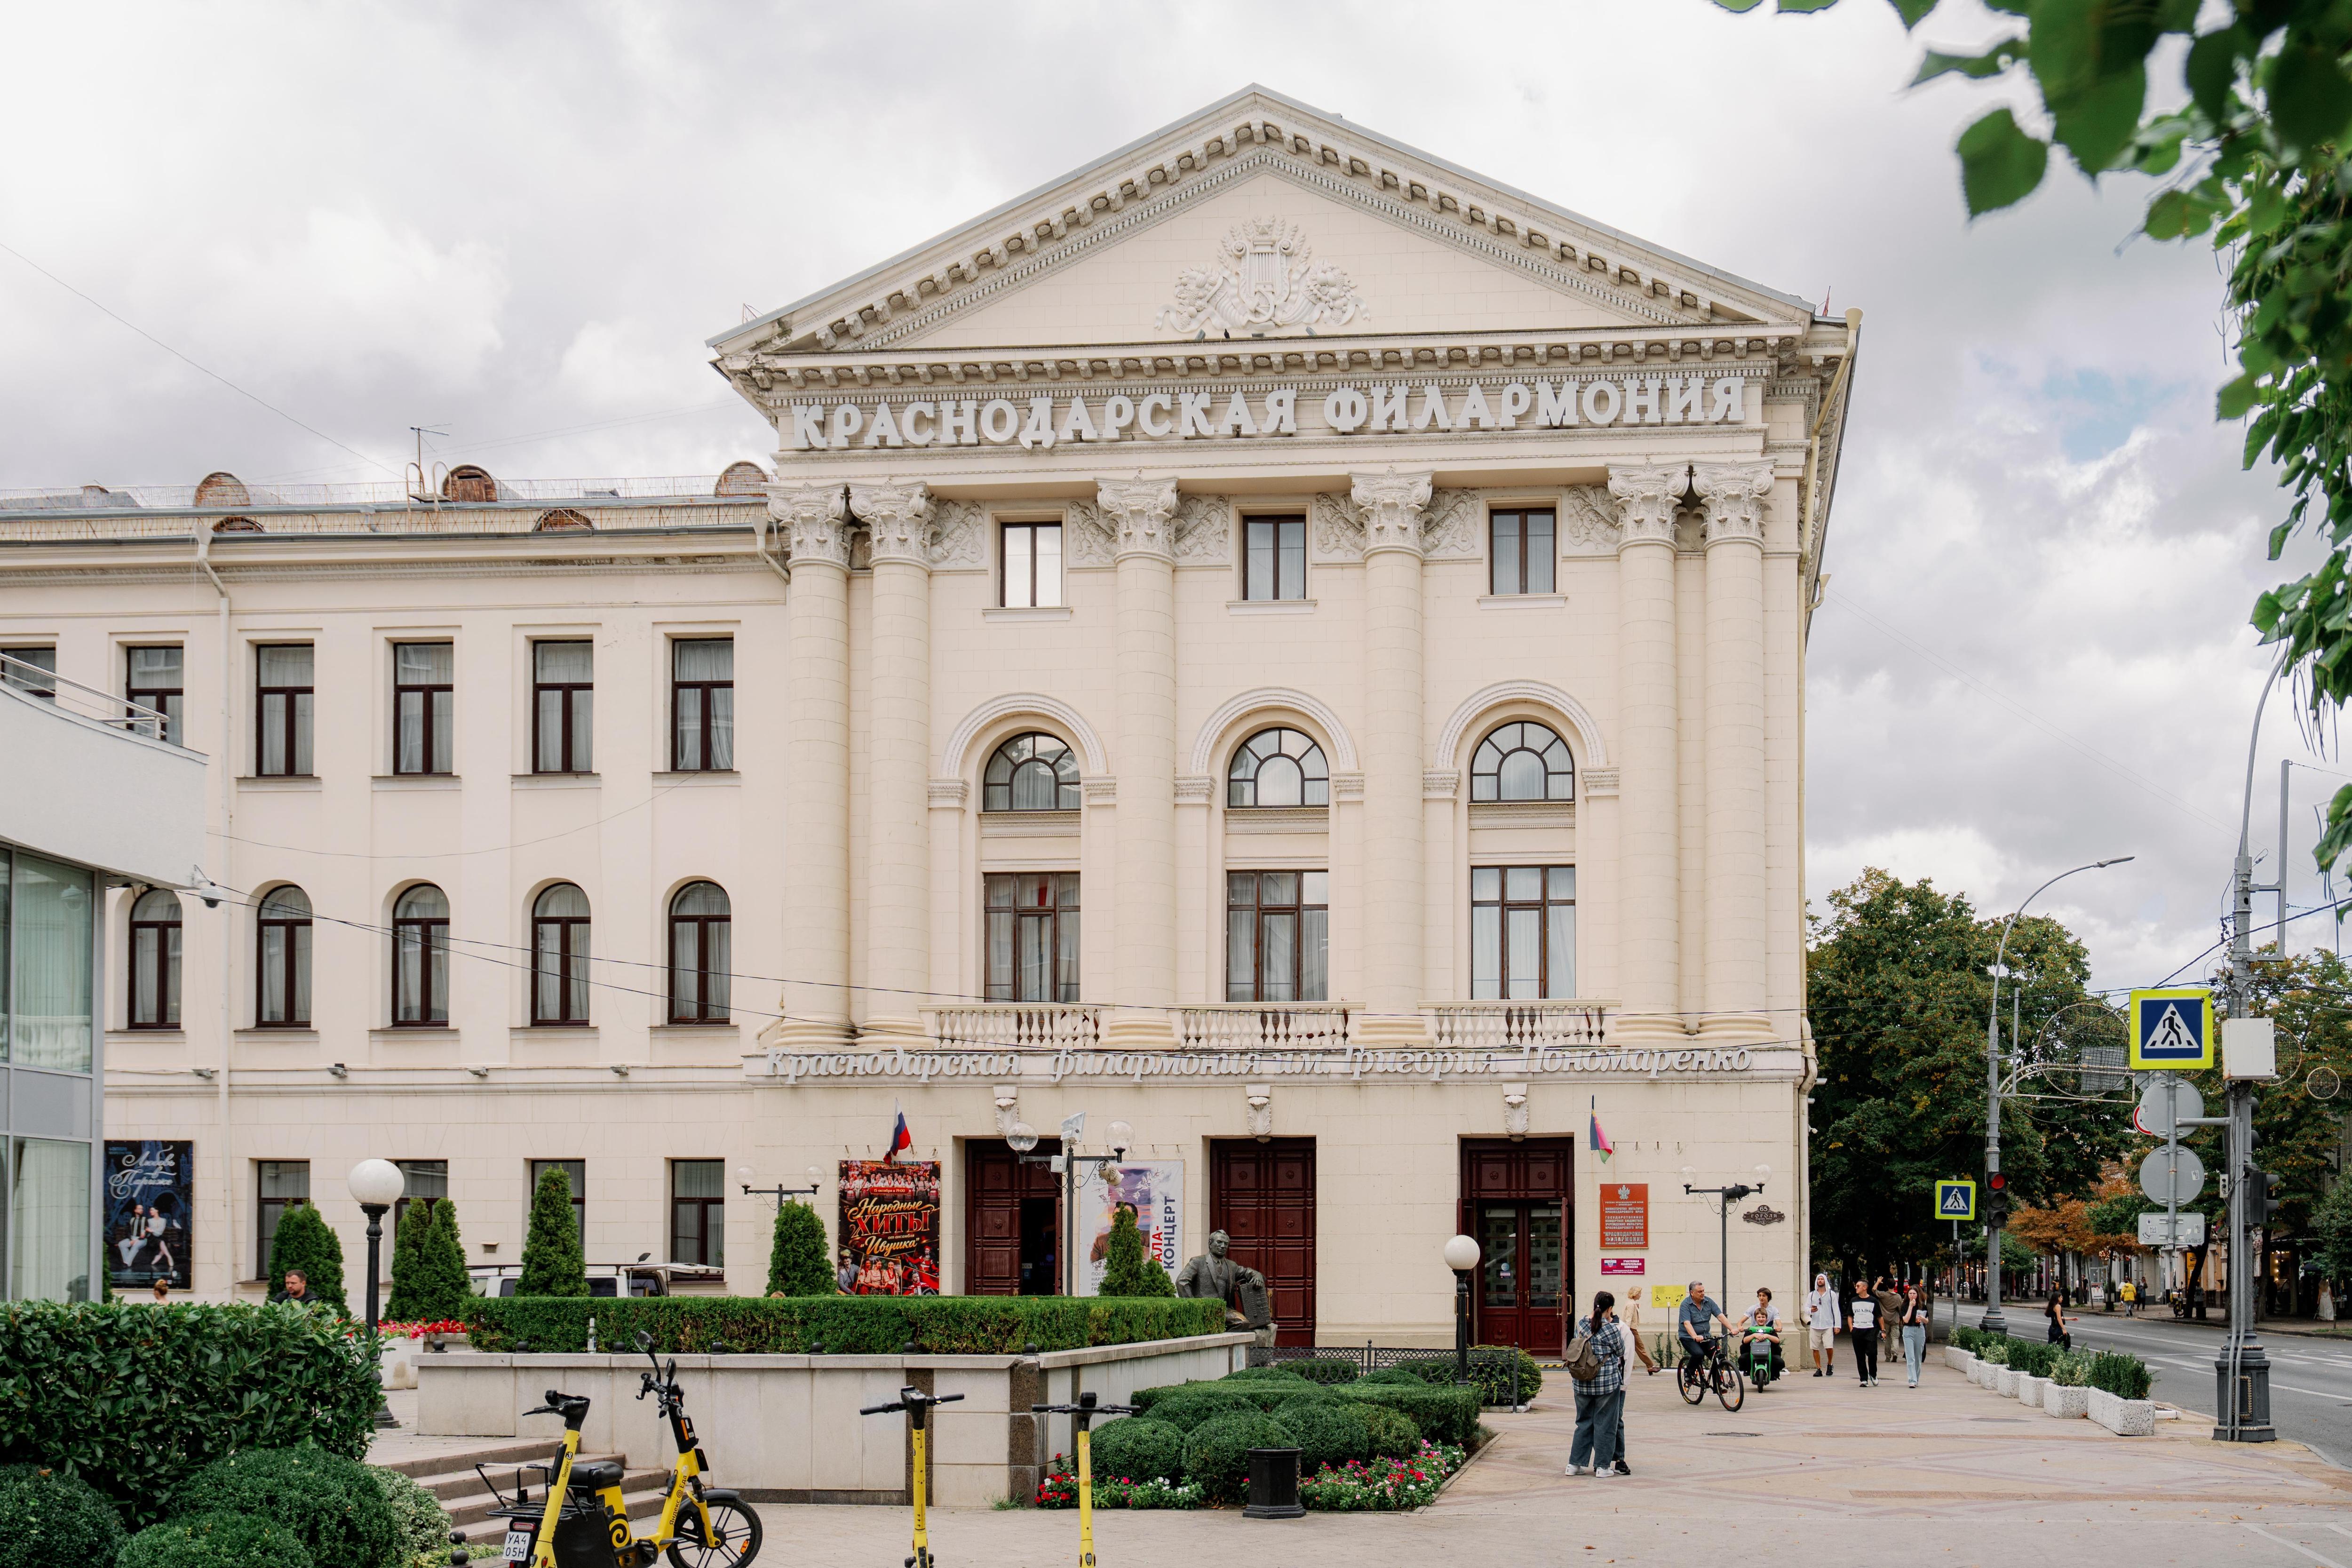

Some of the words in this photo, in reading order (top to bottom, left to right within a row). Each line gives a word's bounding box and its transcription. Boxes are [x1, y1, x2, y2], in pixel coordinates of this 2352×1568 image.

[791, 389, 1297, 450] КРАСНОДАРСКАЯ
[1324, 377, 1745, 433] ФИЛАРМОНИЯ
[766, 1045, 1021, 1084] Краснодарская
[1049, 1049, 1263, 1083] филармония
[1274, 1052, 1331, 1075] им.
[1343, 1046, 1499, 1081] Григория
[1518, 1044, 1752, 1079] Пономаренко
[847, 1197, 935, 1222] Народные
[851, 1210, 930, 1238] ХИТЫ
[1164, 1196, 1177, 1269] КОНЦЕРТ
[669, 1500, 681, 1525] Яндекс
